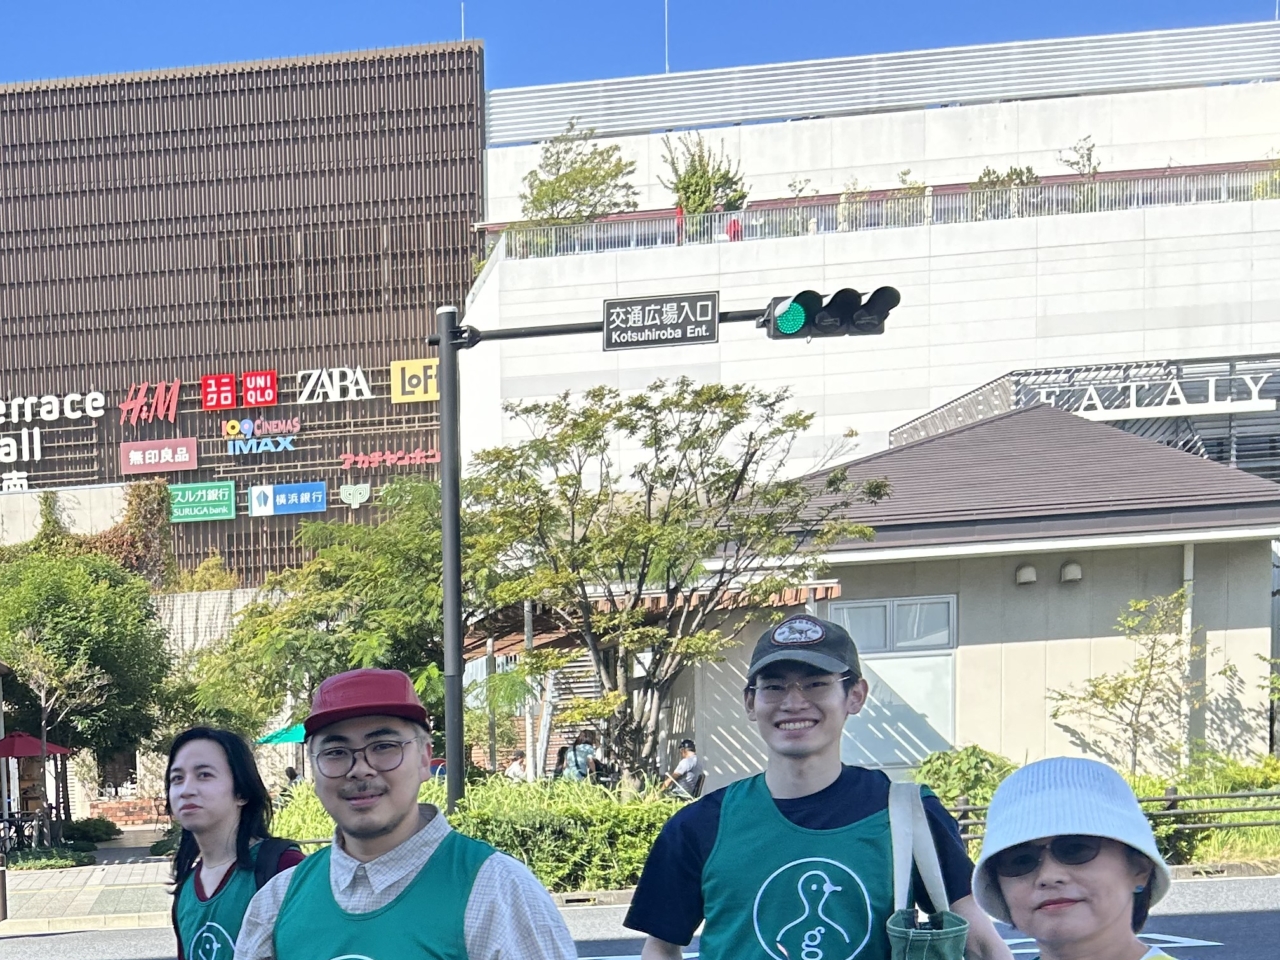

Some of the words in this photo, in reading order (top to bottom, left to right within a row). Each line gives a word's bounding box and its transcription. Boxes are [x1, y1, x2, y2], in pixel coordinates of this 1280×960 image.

[609, 301, 713, 329] 交通広場入口
[611, 327, 682, 343] Kotsuhiroba
[686, 325, 710, 338] Ent.
[246, 375, 272, 389] UNI
[297, 365, 376, 404] ZARA
[119, 378, 181, 427] H&M
[246, 389, 274, 404] QLO
[221, 418, 254, 439] 109
[227, 436, 297, 456] IMAX
[128, 446, 190, 466] 無印良品
[171, 487, 229, 503] スルガ銀行
[276, 491, 323, 506] 横浜銀行
[173, 506, 208, 517] SURUGA
[209, 505, 229, 514] bank
